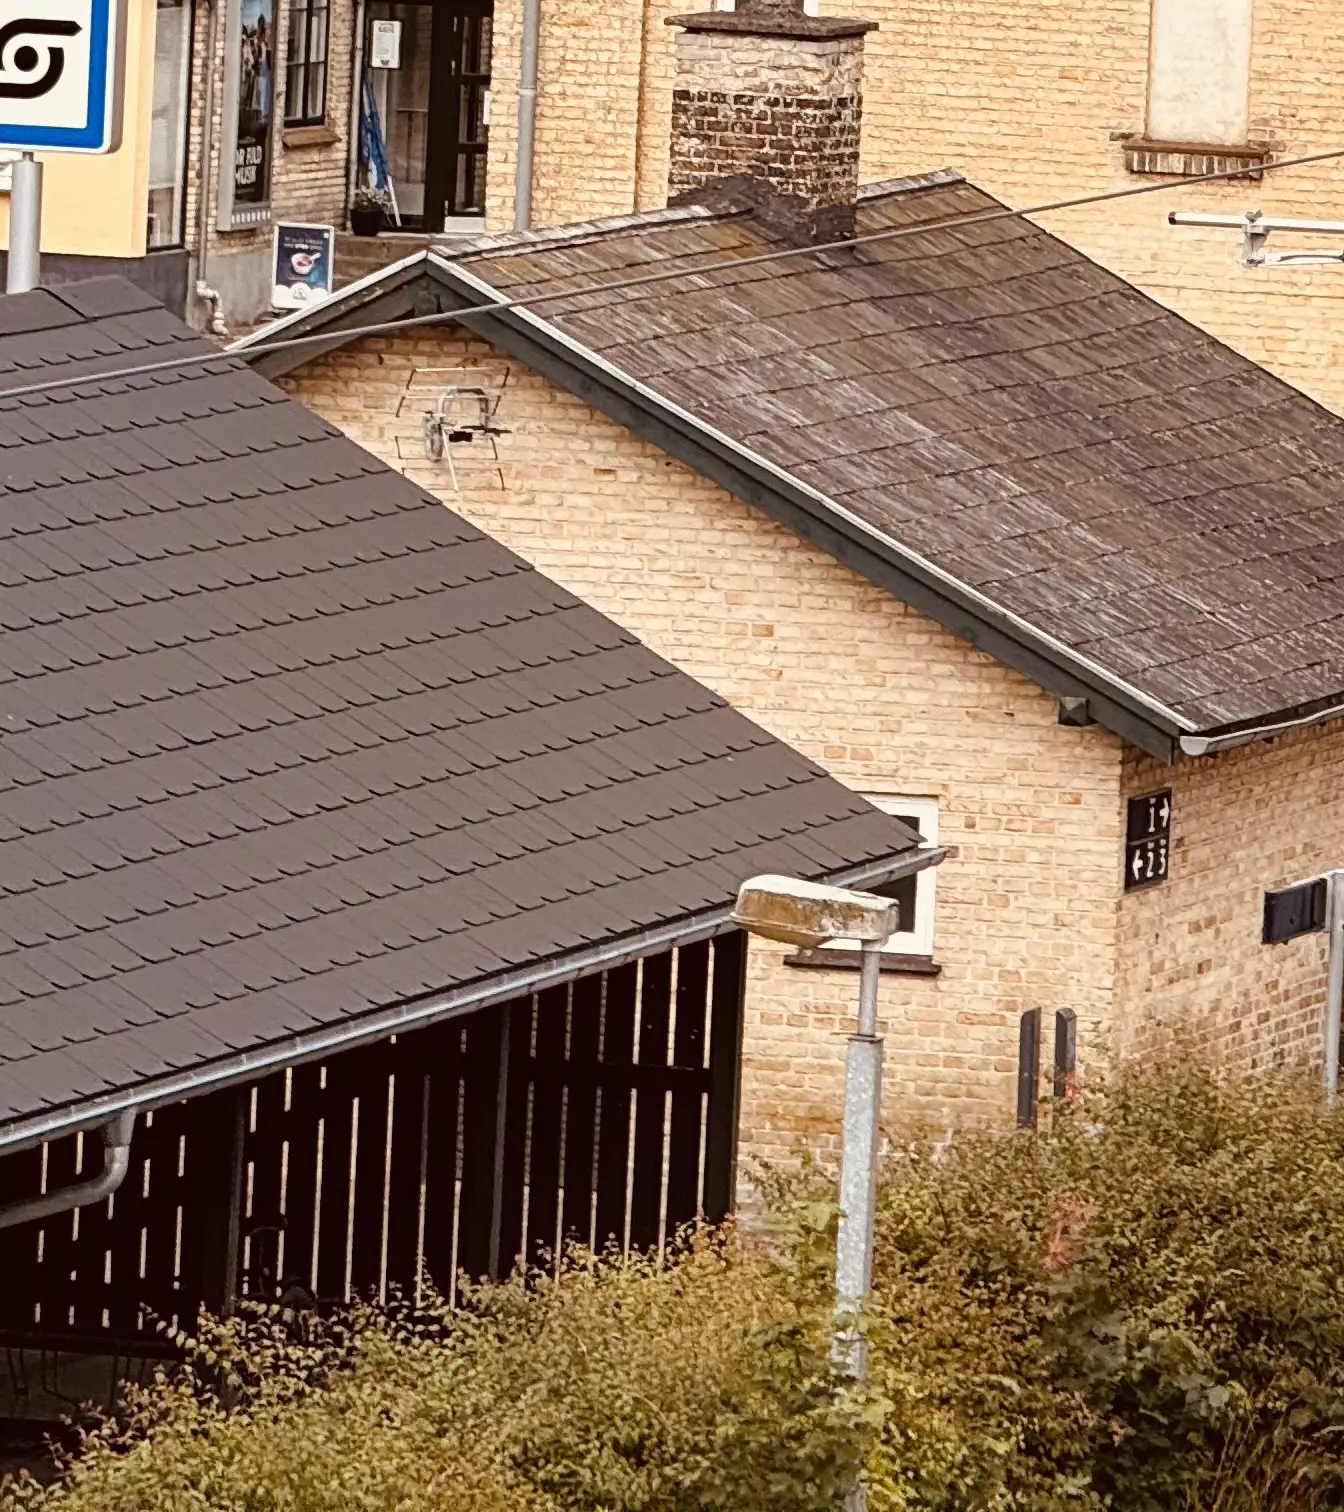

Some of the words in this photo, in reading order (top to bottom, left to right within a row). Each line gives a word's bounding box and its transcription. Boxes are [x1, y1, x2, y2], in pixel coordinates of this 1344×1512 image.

[1148, 806, 1156, 833] 1
[1146, 851, 1154, 878] 2
[1158, 848, 1167, 875] 3
